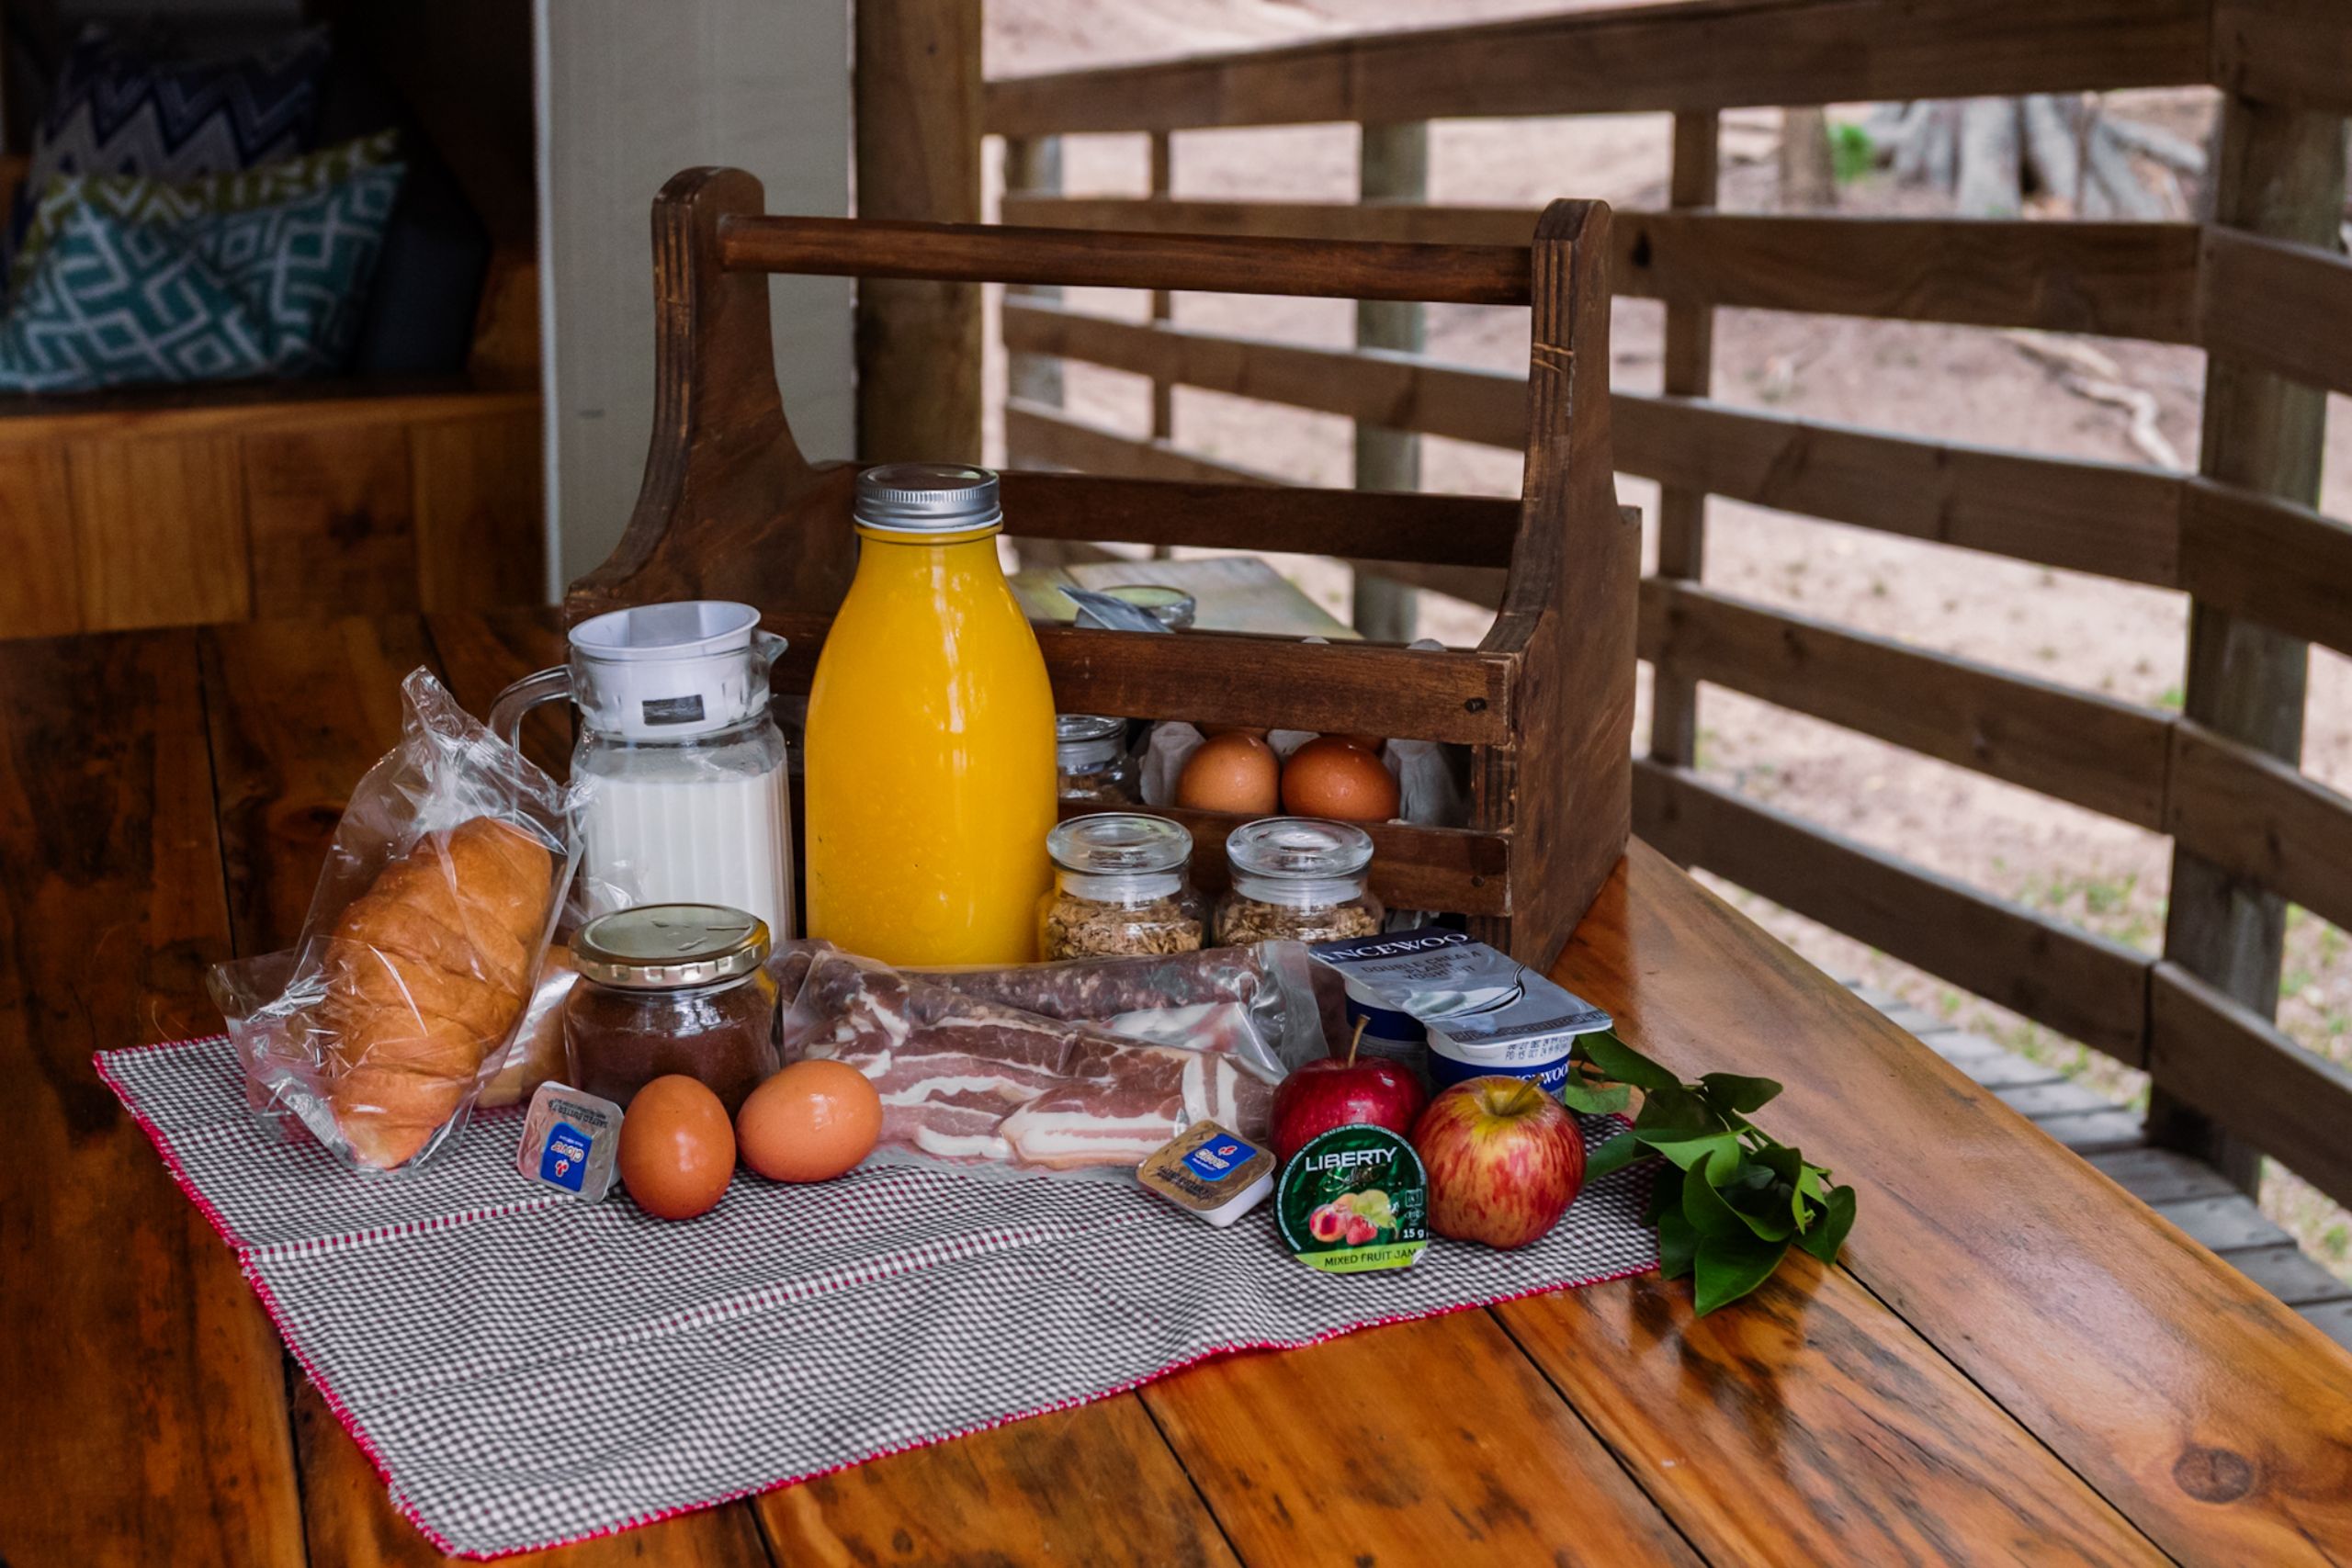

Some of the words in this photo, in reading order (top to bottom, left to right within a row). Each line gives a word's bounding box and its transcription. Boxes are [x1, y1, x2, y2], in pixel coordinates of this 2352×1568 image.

[1362, 960, 1424, 974] DOUBLE
[1404, 962, 1453, 974] PLAIN
[1404, 965, 1476, 980] YOGHT
[551, 1140, 584, 1163] Clover
[1195, 1148, 1230, 1169] Clover
[1306, 1146, 1397, 1172] LIBERTY
[1403, 1228, 1415, 1238] 15
[1417, 1229, 1424, 1238] g
[1324, 1255, 1358, 1267] MIXED
[1361, 1250, 1391, 1263] FRUIT
[1395, 1248, 1417, 1259] JAM
